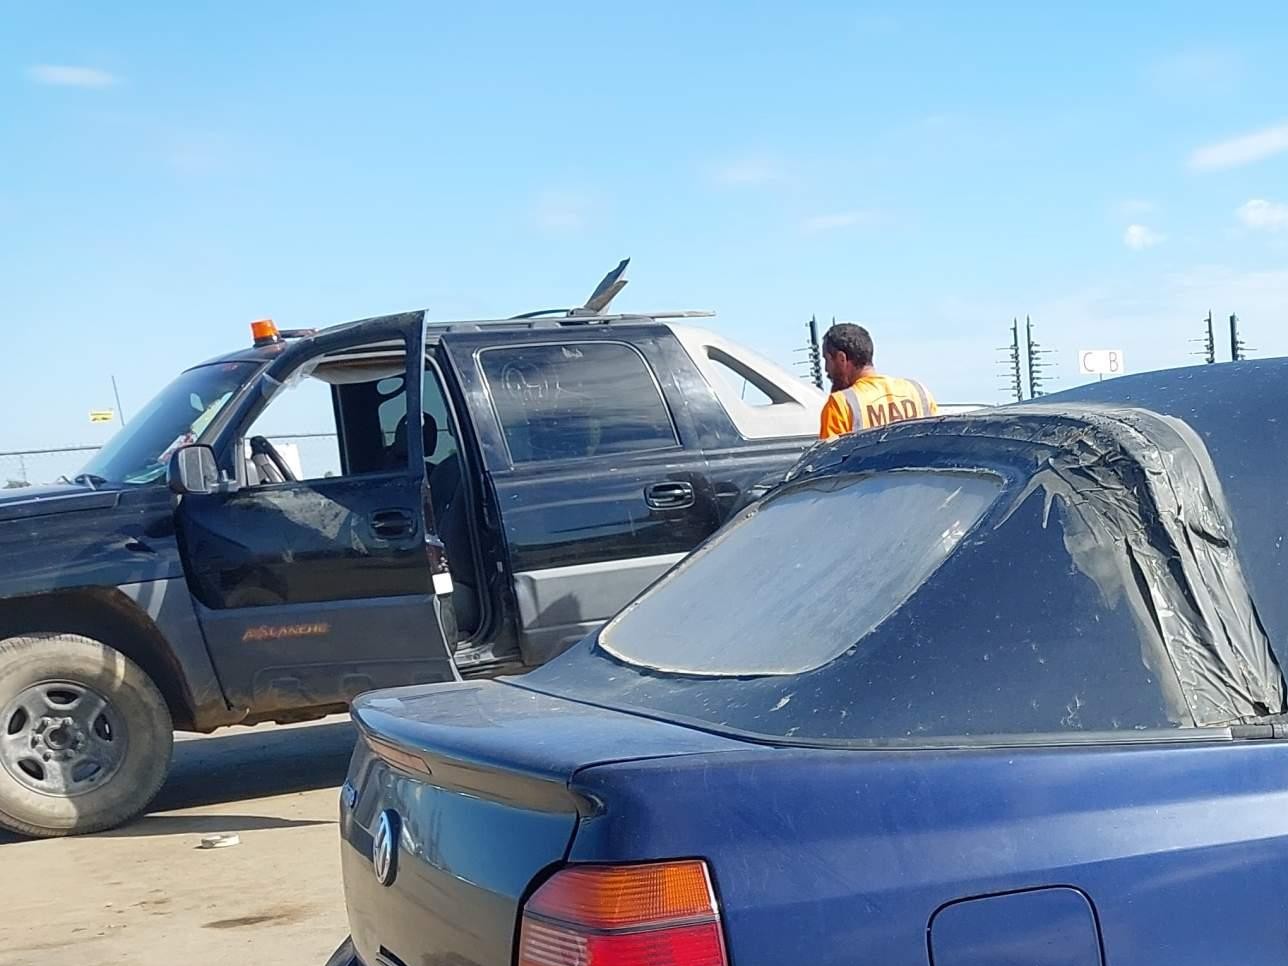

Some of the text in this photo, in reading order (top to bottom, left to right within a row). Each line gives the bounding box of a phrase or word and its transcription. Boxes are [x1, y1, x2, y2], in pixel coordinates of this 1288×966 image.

[1083, 351, 1119, 372] C B
[866, 399, 918, 428] MAD
